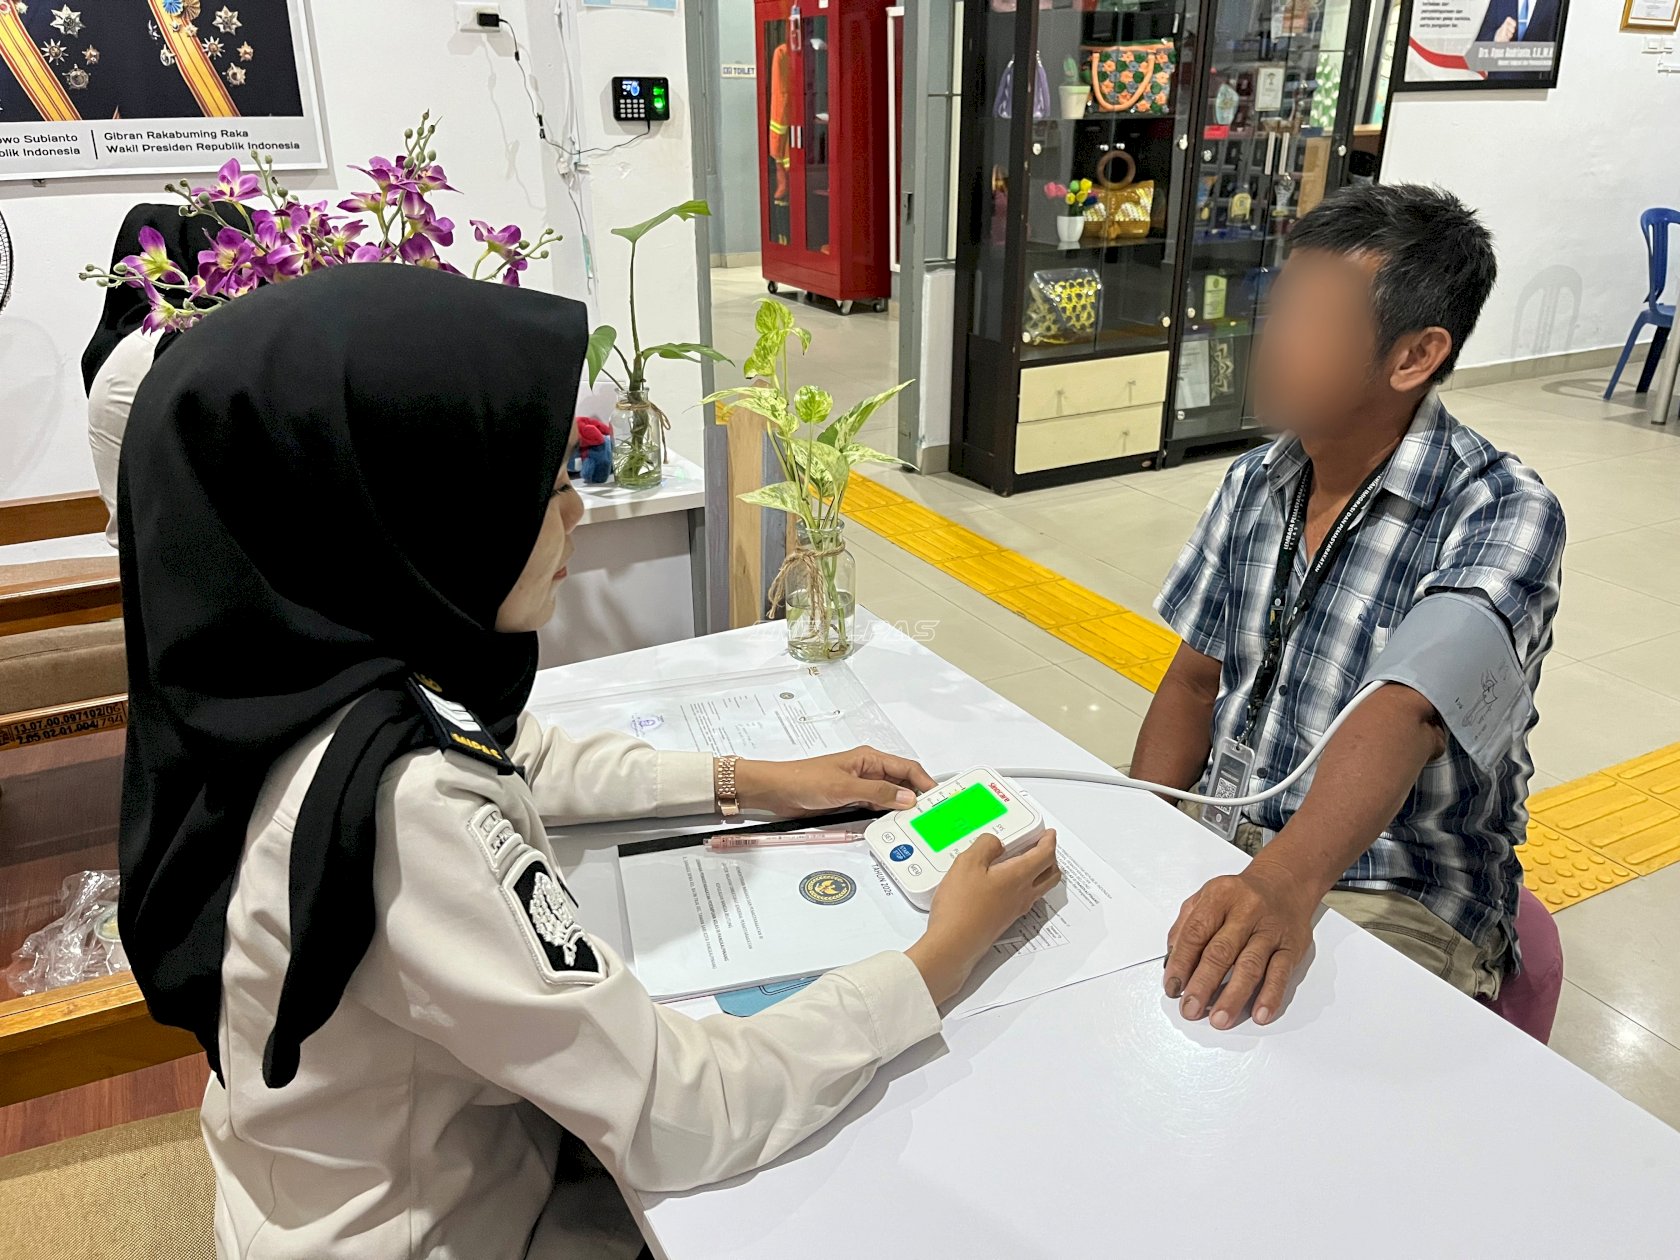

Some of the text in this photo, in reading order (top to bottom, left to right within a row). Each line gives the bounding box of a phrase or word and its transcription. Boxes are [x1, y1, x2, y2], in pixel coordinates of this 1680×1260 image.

[733, 67, 754, 75] TOILET
[24, 133, 78, 143] Subianto
[104, 129, 249, 141] Gibran Rakabuming Raka
[24, 146, 80, 156] Indonesia
[106, 141, 300, 153] Wakil Presiden Republik Indonesia
[1348, 488, 1369, 513] IMIGRASI
[1340, 511, 1352, 525] DAN
[1282, 522, 1294, 550] LEMBAGA
[1313, 522, 1344, 573] PEMASYARAKATAN
[871, 862, 893, 897] TAHUN 2026
